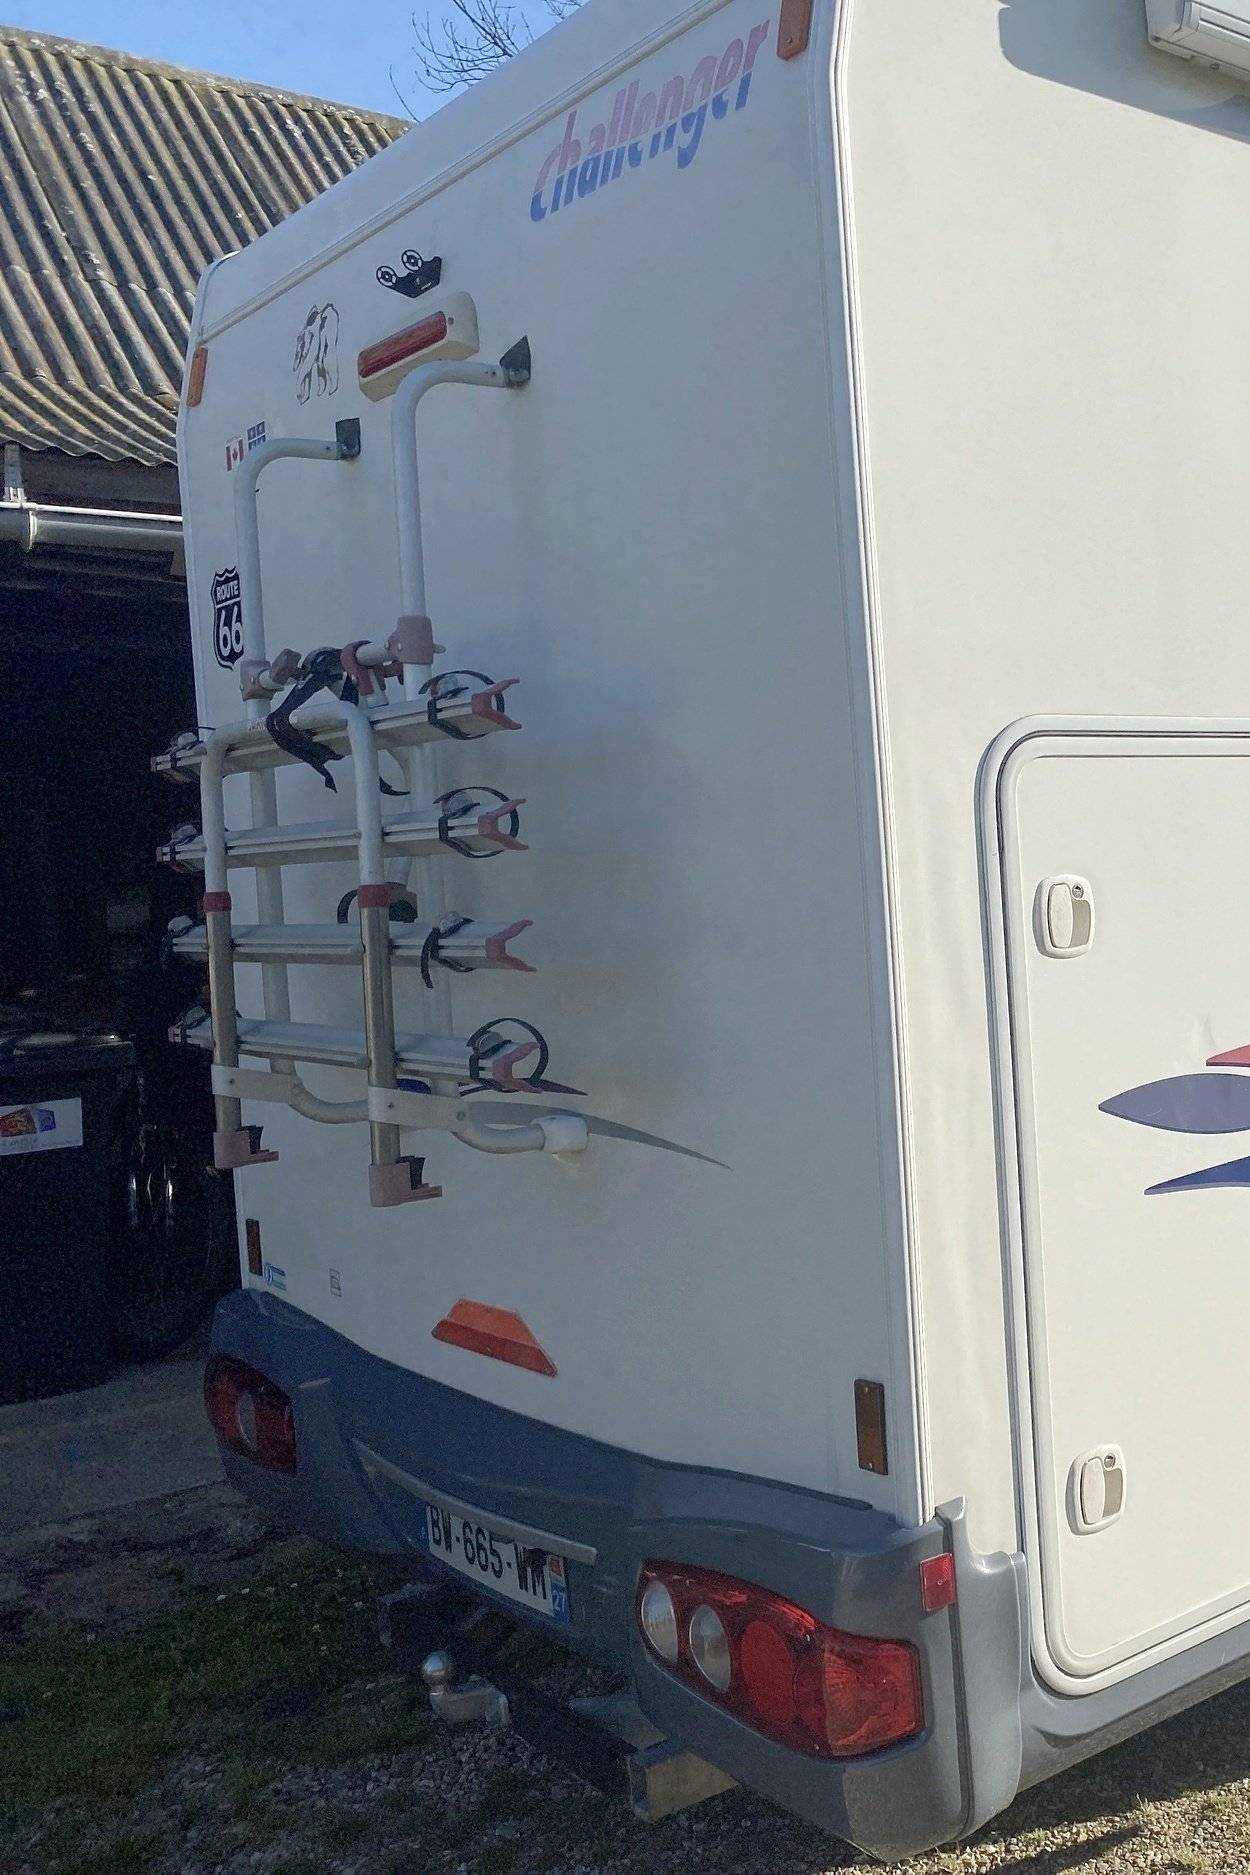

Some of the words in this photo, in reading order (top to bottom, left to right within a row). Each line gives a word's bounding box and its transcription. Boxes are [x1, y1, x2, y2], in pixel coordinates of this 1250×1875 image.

[216, 580, 239, 601] ROUTE
[220, 605, 243, 657] 66
[553, 1590, 566, 1613] 27
